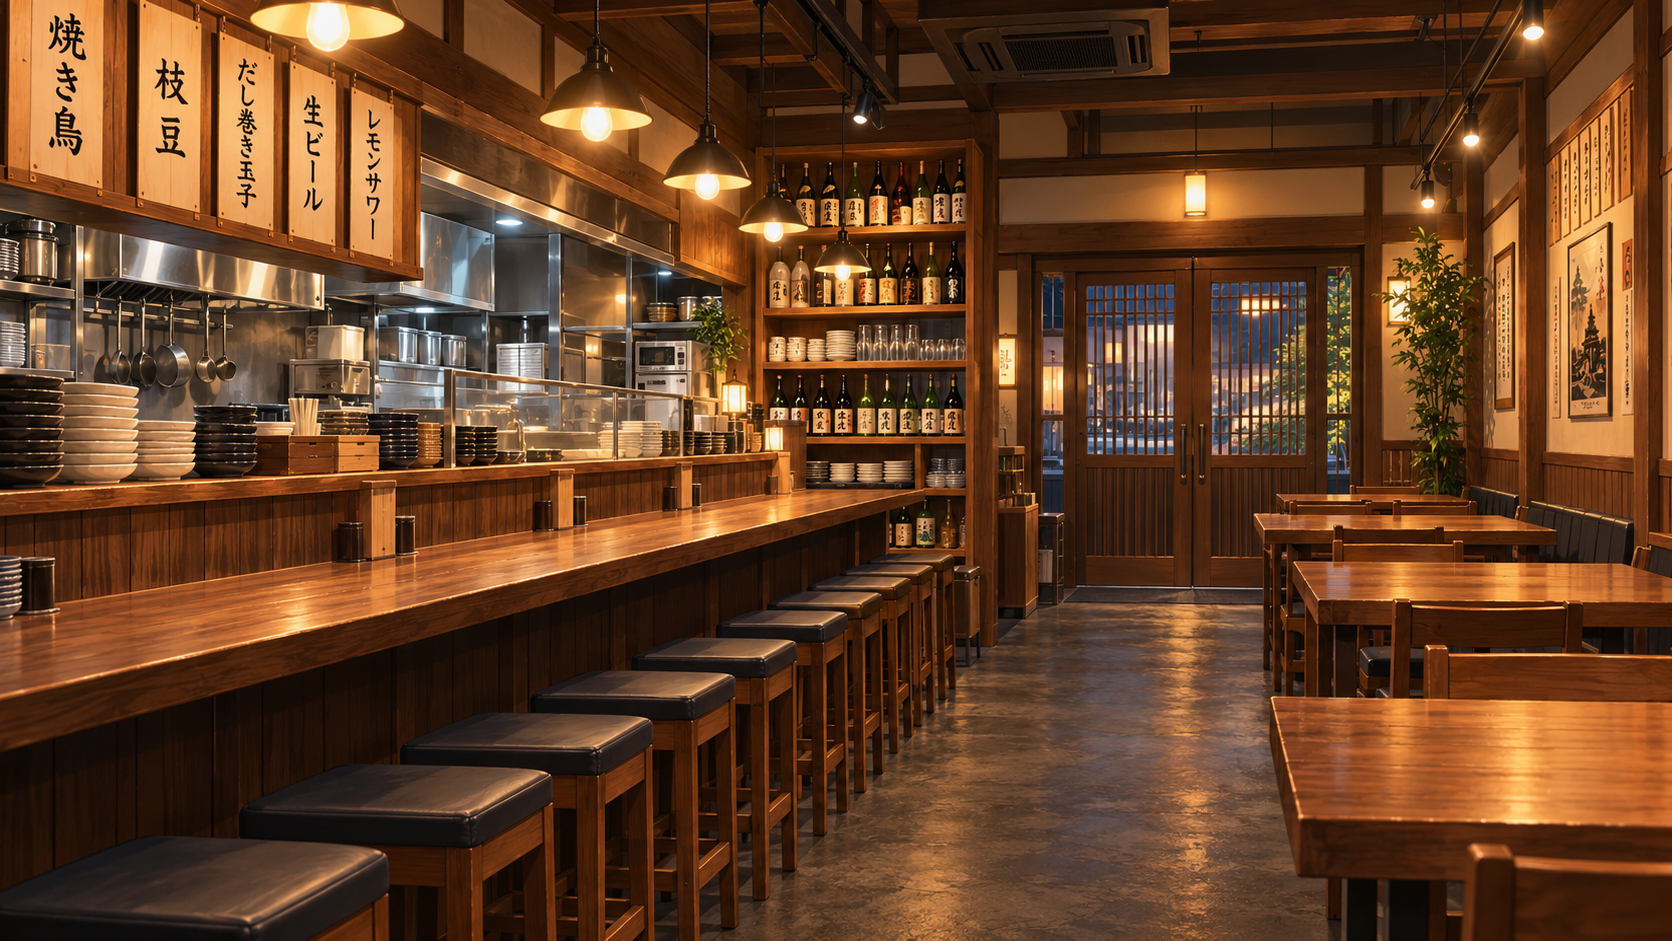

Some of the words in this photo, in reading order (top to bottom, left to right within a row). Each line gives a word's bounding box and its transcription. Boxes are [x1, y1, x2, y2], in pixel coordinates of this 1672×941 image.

[48, 13, 87, 156] 焼き鳥
[154, 58, 189, 159] 枝豆
[236, 58, 258, 209] だし巻き玉子
[303, 95, 324, 212] 生ビール
[365, 109, 382, 240] レモンサワー
